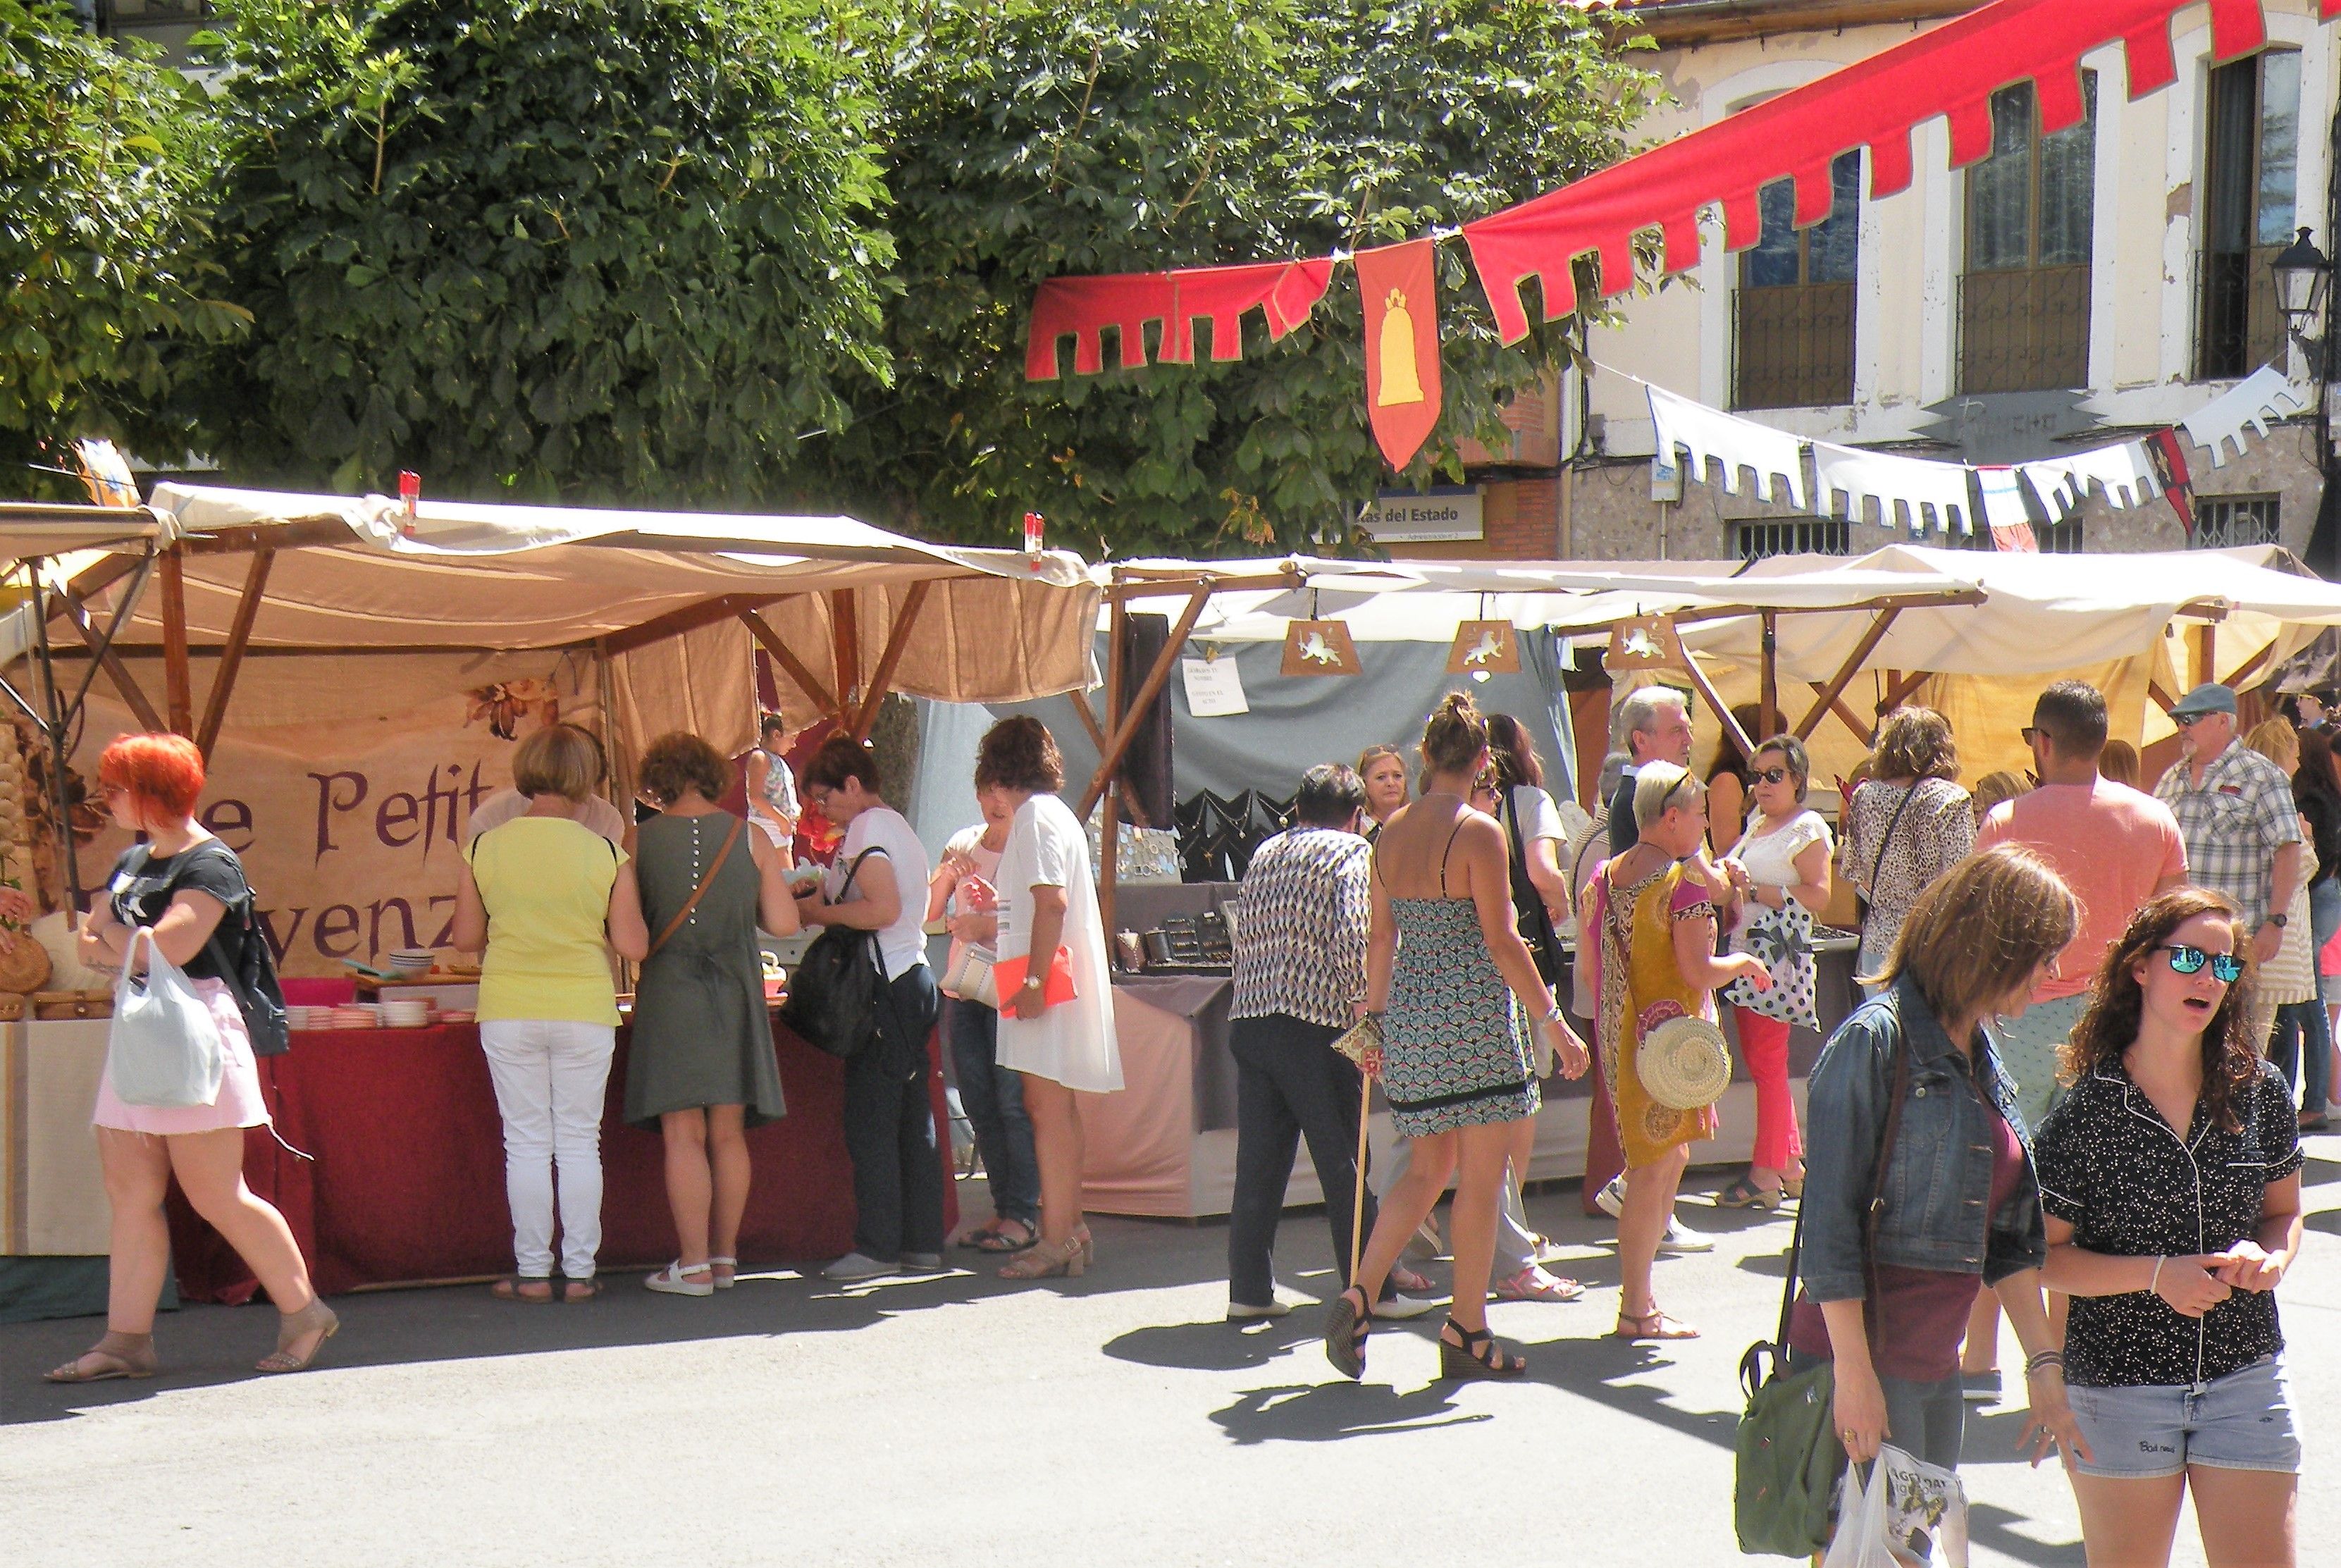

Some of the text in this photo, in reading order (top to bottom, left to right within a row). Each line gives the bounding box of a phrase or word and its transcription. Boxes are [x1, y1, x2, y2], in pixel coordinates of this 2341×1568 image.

[1385, 507, 1406, 523] del
[1411, 507, 1459, 522] Estado
[307, 758, 494, 870] Petit
